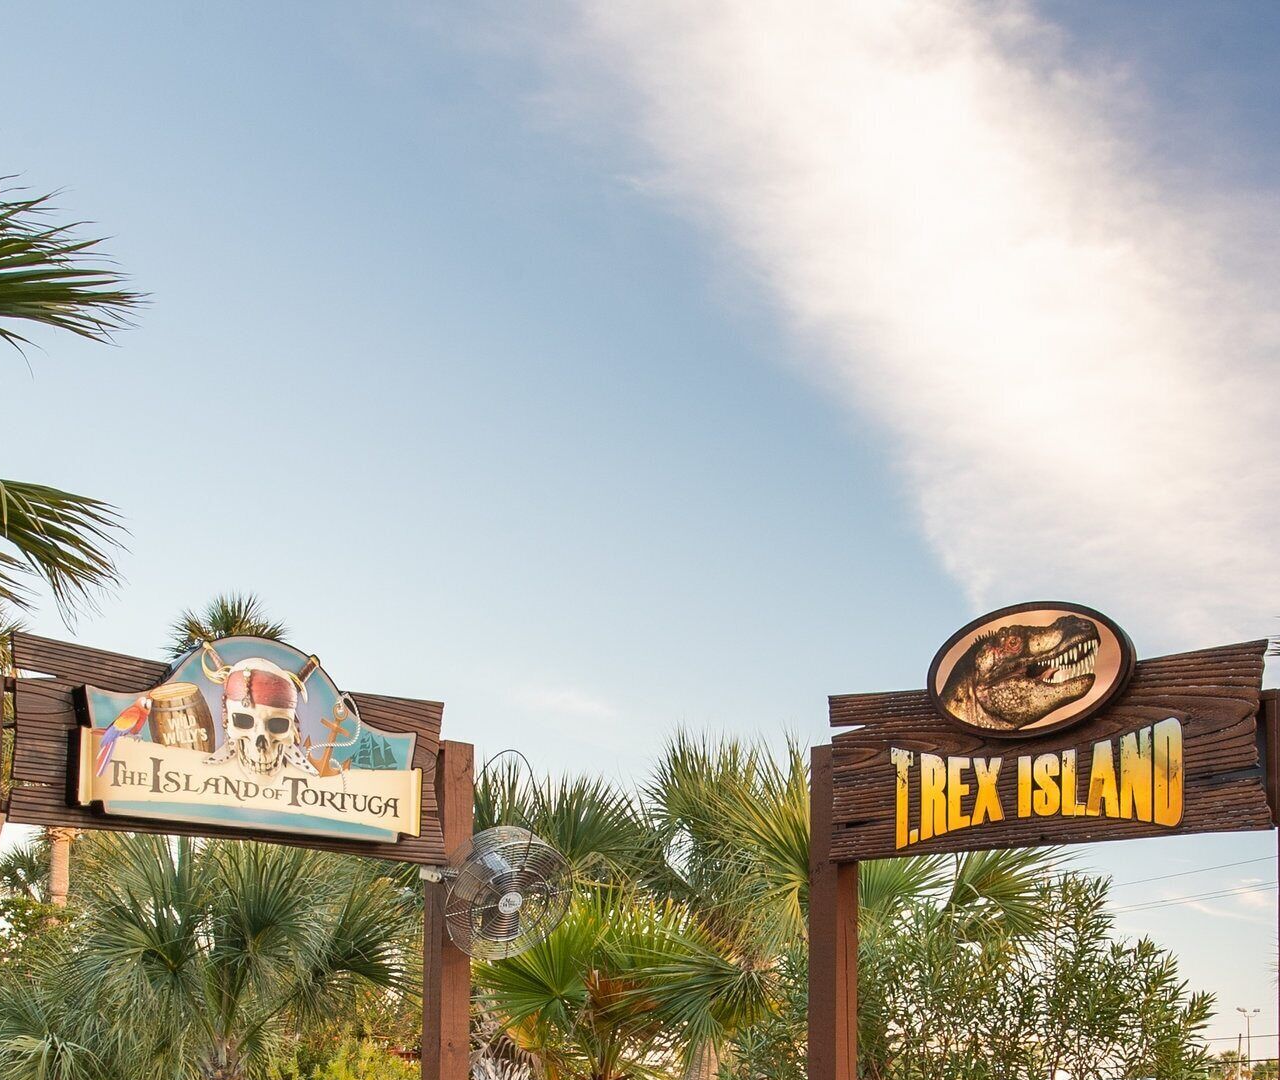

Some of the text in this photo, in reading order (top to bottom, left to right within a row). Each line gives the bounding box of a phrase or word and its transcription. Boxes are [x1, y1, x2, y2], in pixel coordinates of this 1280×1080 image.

[167, 714, 197, 731] WILD
[890, 716, 1185, 851] T.REX ISLAND
